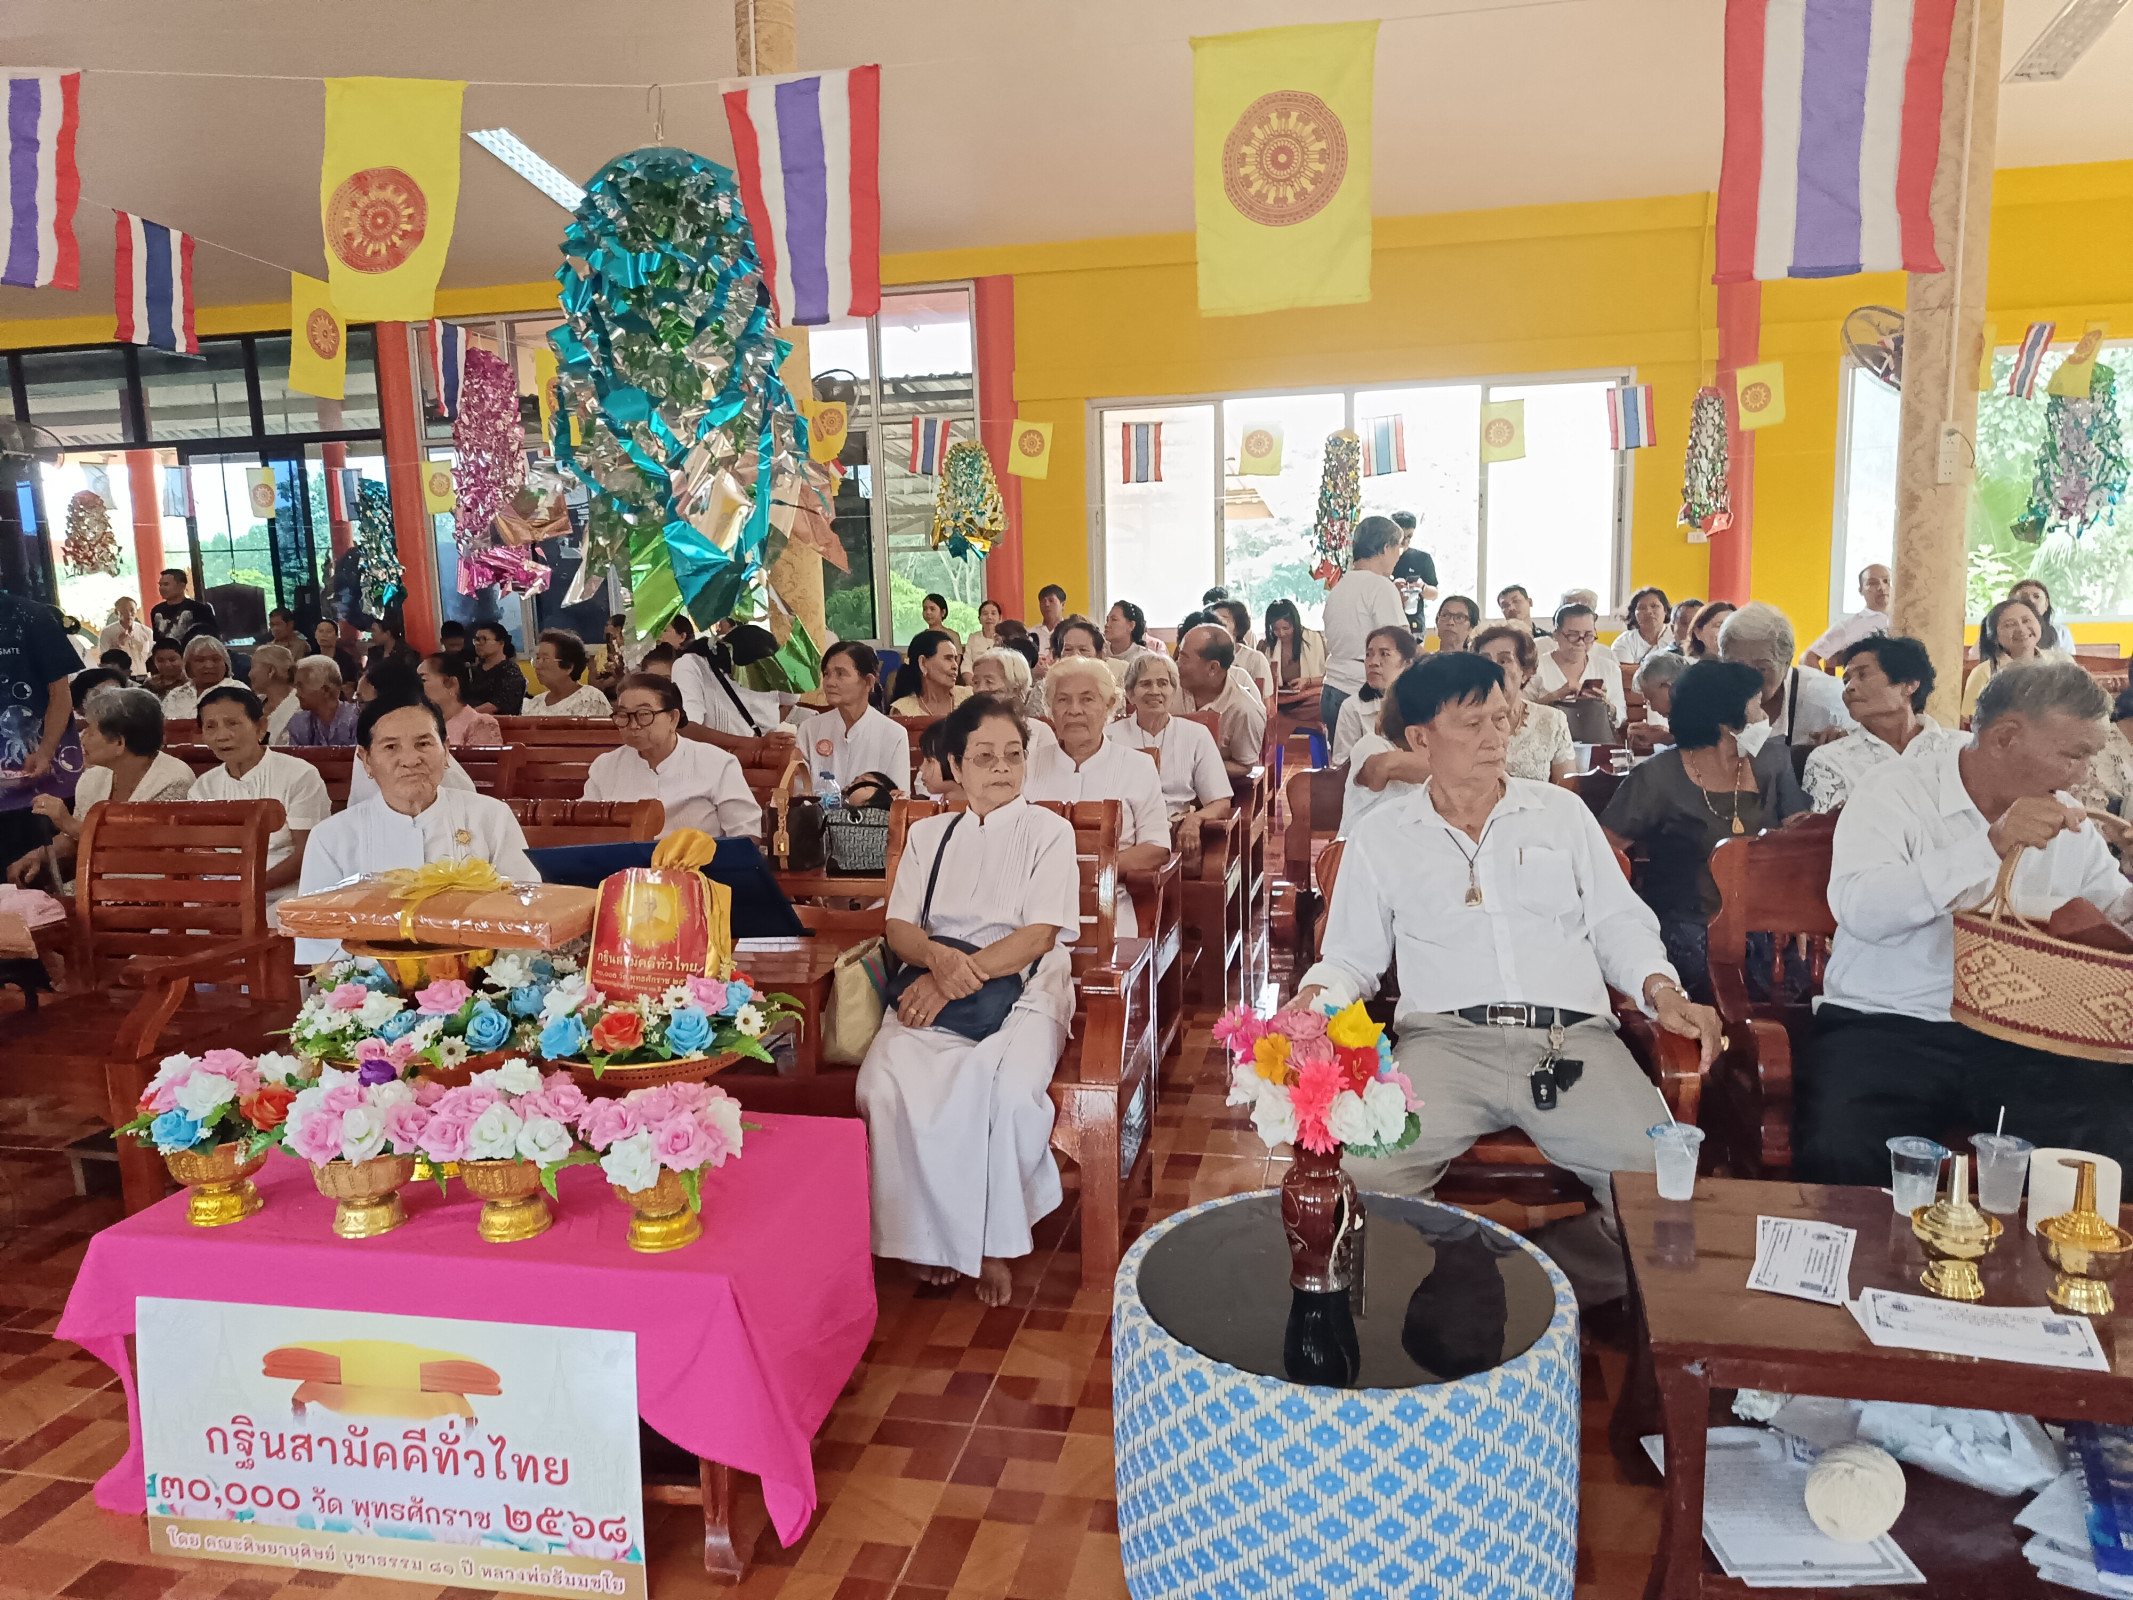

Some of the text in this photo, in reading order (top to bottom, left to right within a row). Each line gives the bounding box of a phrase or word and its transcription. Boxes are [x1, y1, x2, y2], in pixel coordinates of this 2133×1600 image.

[597, 949, 697, 972] กฐินสมัคคีทั่วไทย
[206, 1415, 568, 1485] กฐินสามัคคีทั่วไทย
[160, 1476, 627, 1544] ๓๐,๐๐๐ วัด พุทธศักราช ๒๕๖๘
[167, 1526, 200, 1548] โดย
[461, 1559, 474, 1577] ปี
